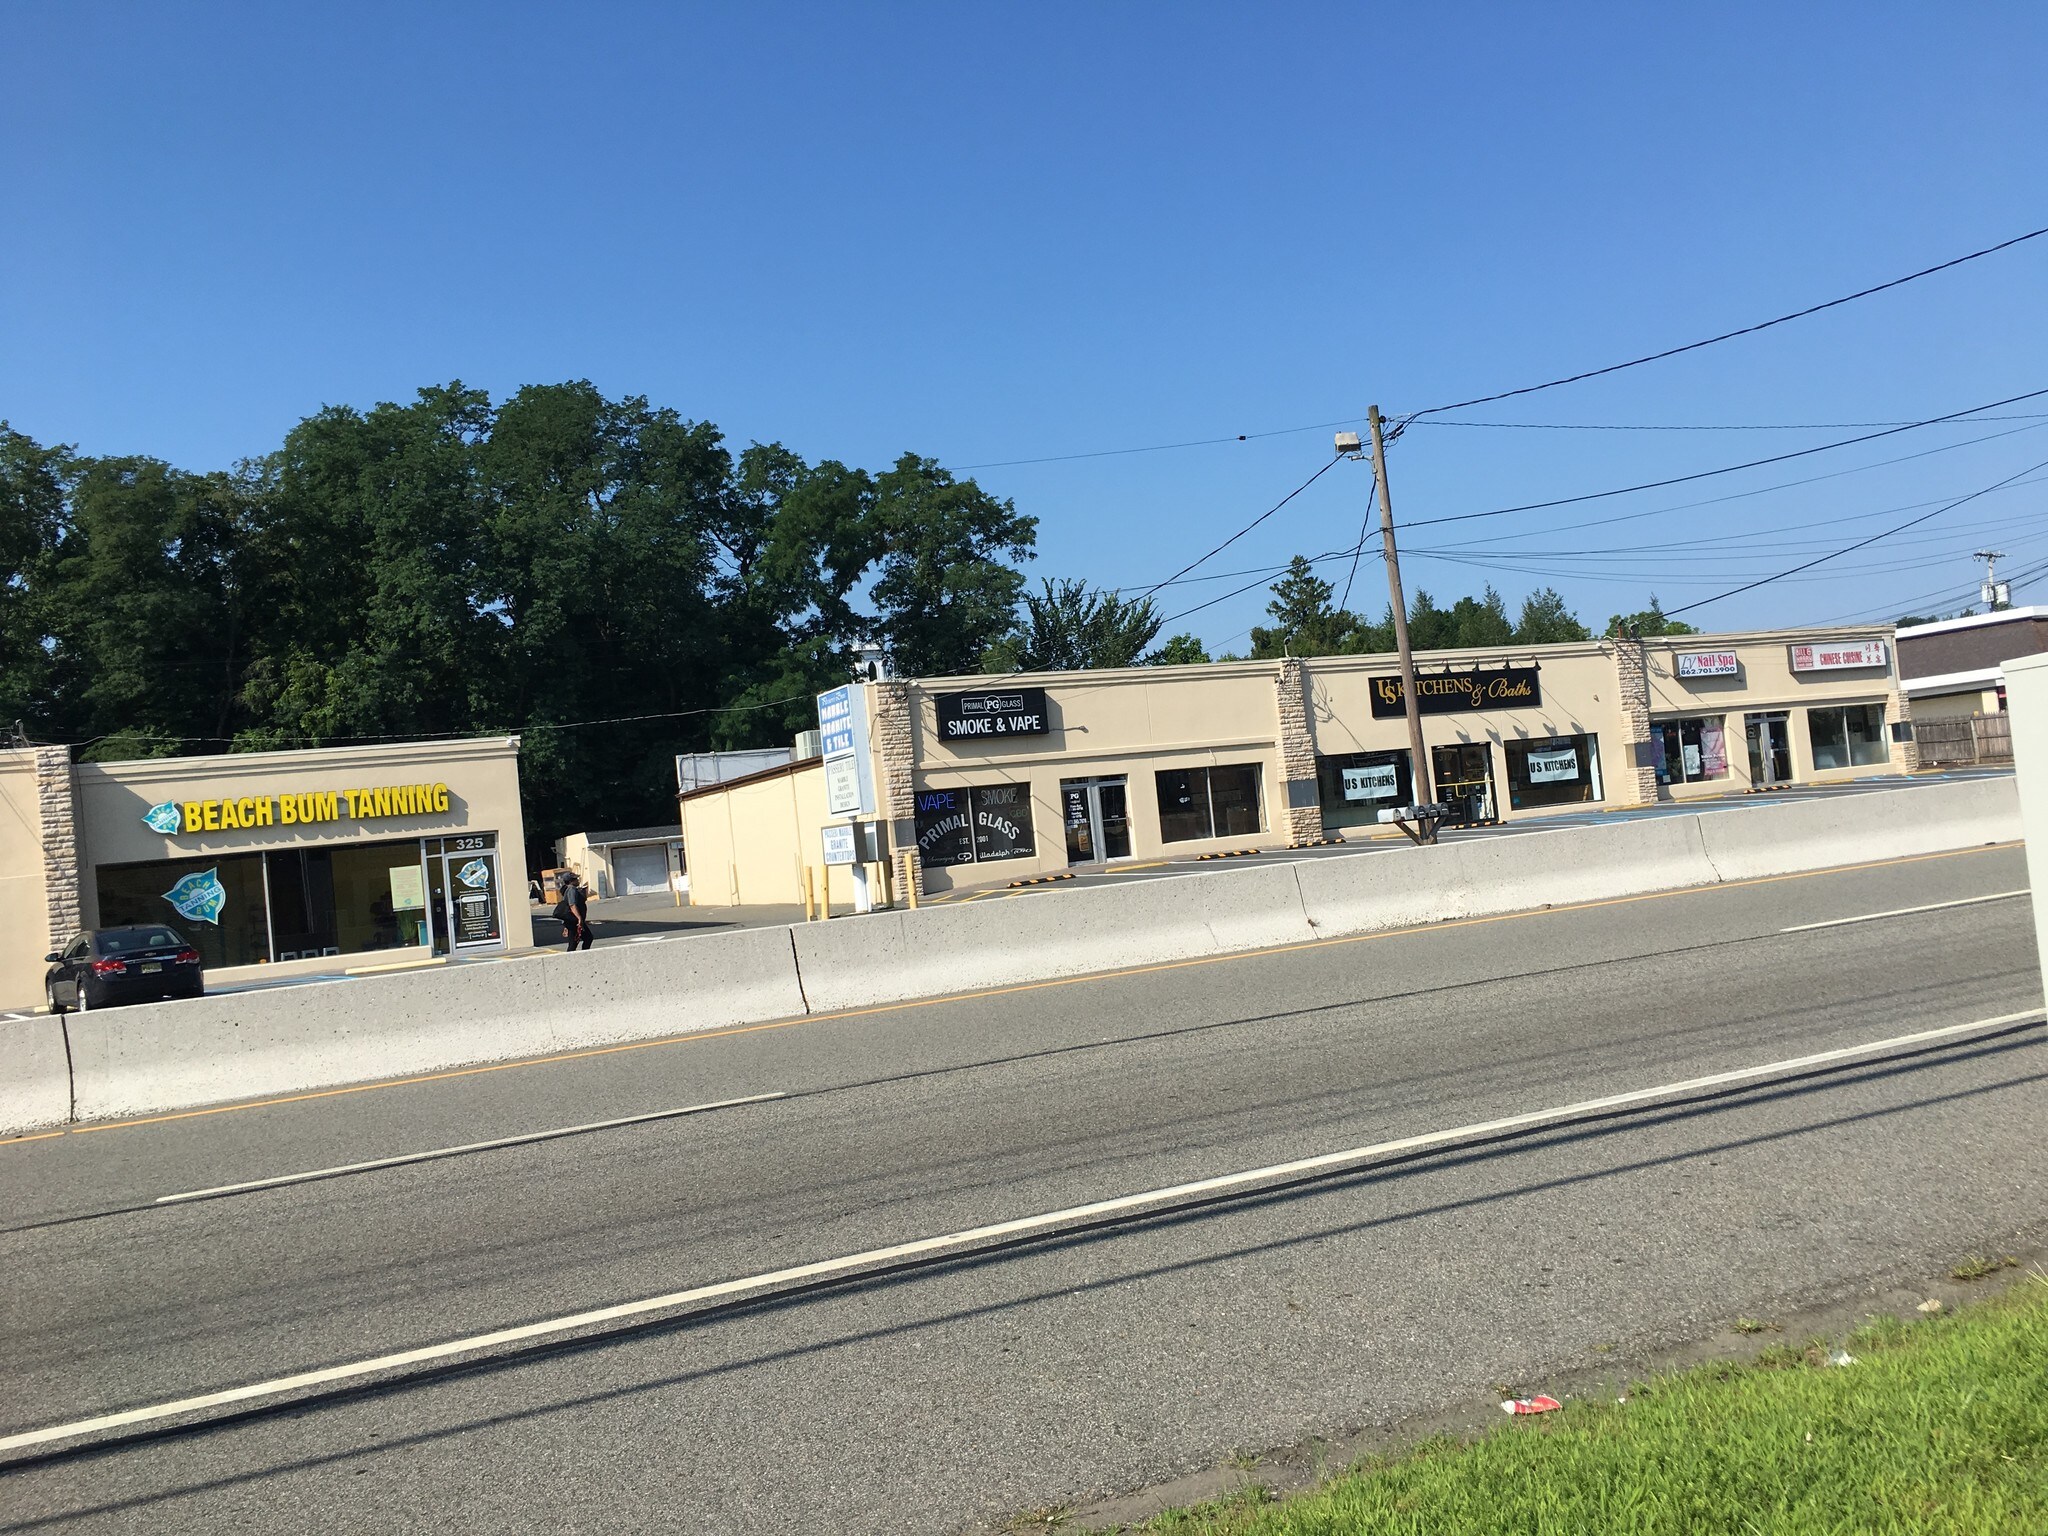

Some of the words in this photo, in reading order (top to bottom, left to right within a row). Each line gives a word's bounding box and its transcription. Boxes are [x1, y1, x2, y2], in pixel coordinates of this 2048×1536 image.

[1697, 655, 1715, 667] Nail
[1717, 654, 1735, 667] Spa
[1820, 653, 1842, 666] CHINESE
[1842, 651, 1863, 664] CUISINE
[1681, 667, 1736, 676] 862.701.5900
[1376, 679, 1397, 705] US
[1397, 677, 1472, 697] KTCHENS
[1471, 683, 1486, 707] &
[1488, 677, 1533, 698] Baths
[963, 702, 984, 710] PRIMAL
[986, 700, 1000, 710] PG
[1001, 700, 1021, 708] GLASS
[948, 718, 993, 736] SMOKE
[996, 717, 1006, 732] &
[1009, 715, 1041, 731] VAPE
[1543, 758, 1576, 772] KITCHENS
[1360, 774, 1395, 789] KITCHENS
[918, 792, 955, 811] VAPE
[980, 787, 1018, 806] SMOKE
[183, 796, 273, 833] BEACH
[279, 790, 339, 825] BUM
[344, 782, 449, 819] TANNING
[919, 813, 969, 850] PRIMAL
[978, 811, 1020, 840] GLASS
[456, 837, 484, 850] 325
[180, 879, 211, 900] BEACH
[180, 886, 221, 912] TANNING
